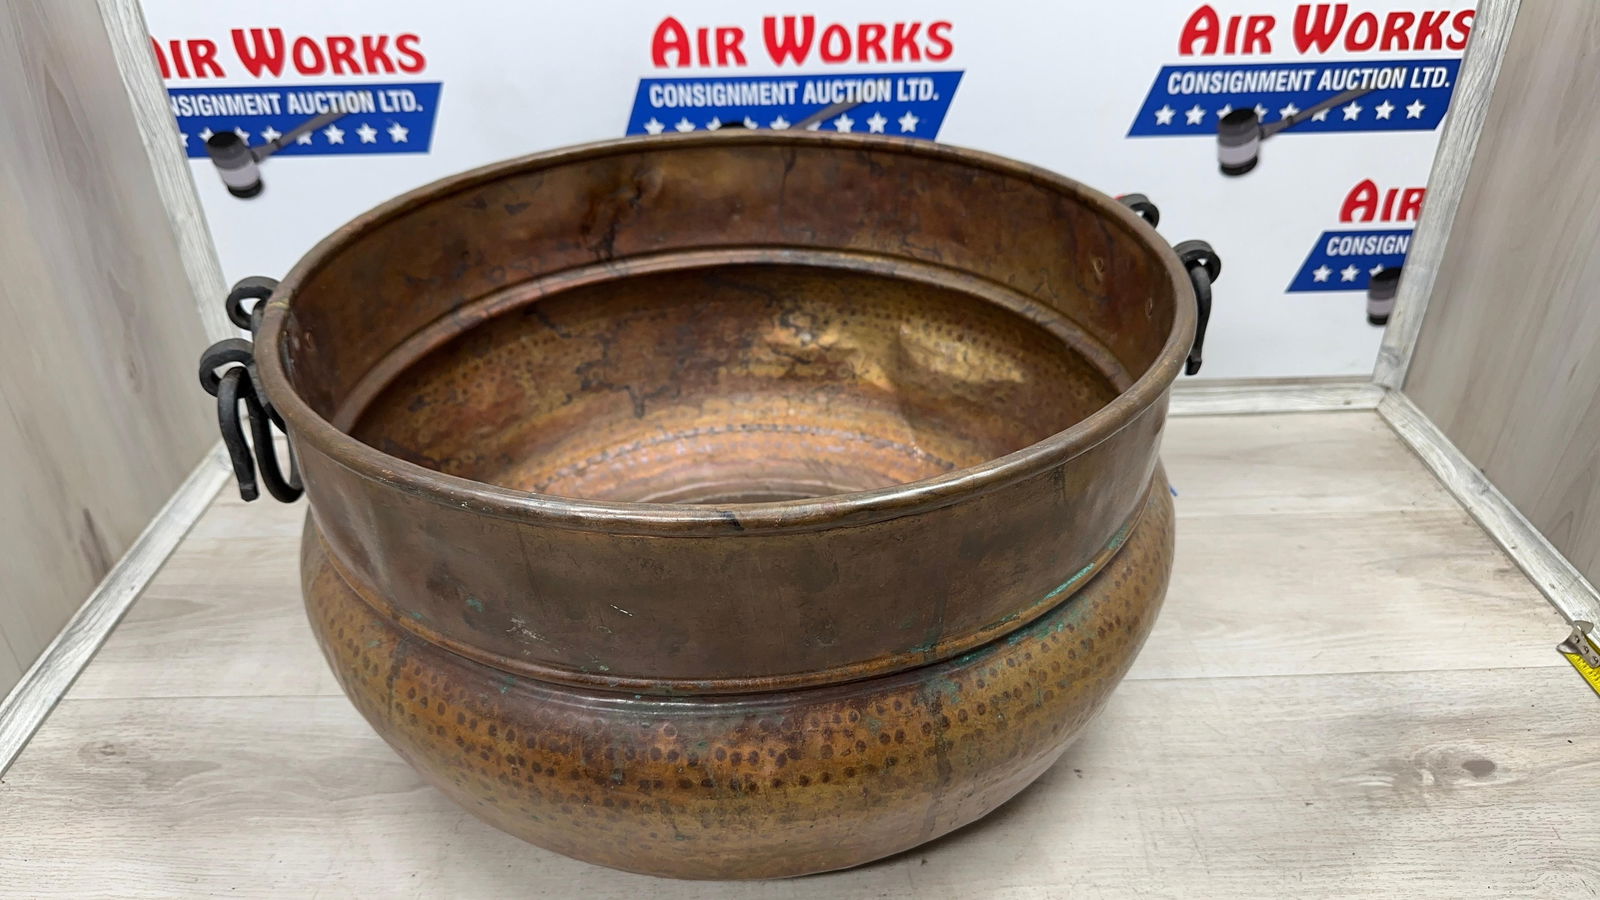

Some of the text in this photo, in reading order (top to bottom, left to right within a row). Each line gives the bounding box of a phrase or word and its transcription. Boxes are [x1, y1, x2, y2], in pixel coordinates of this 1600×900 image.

[649, 77, 940, 108] CONSIGNMENT AUCTION LTD.
[1167, 67, 1451, 96] CONSIGNMENT AUCTION LTD.
[287, 90, 376, 115] AUCTION
[377, 89, 424, 113] LTD.
[1325, 234, 1411, 257] CONSIGN
